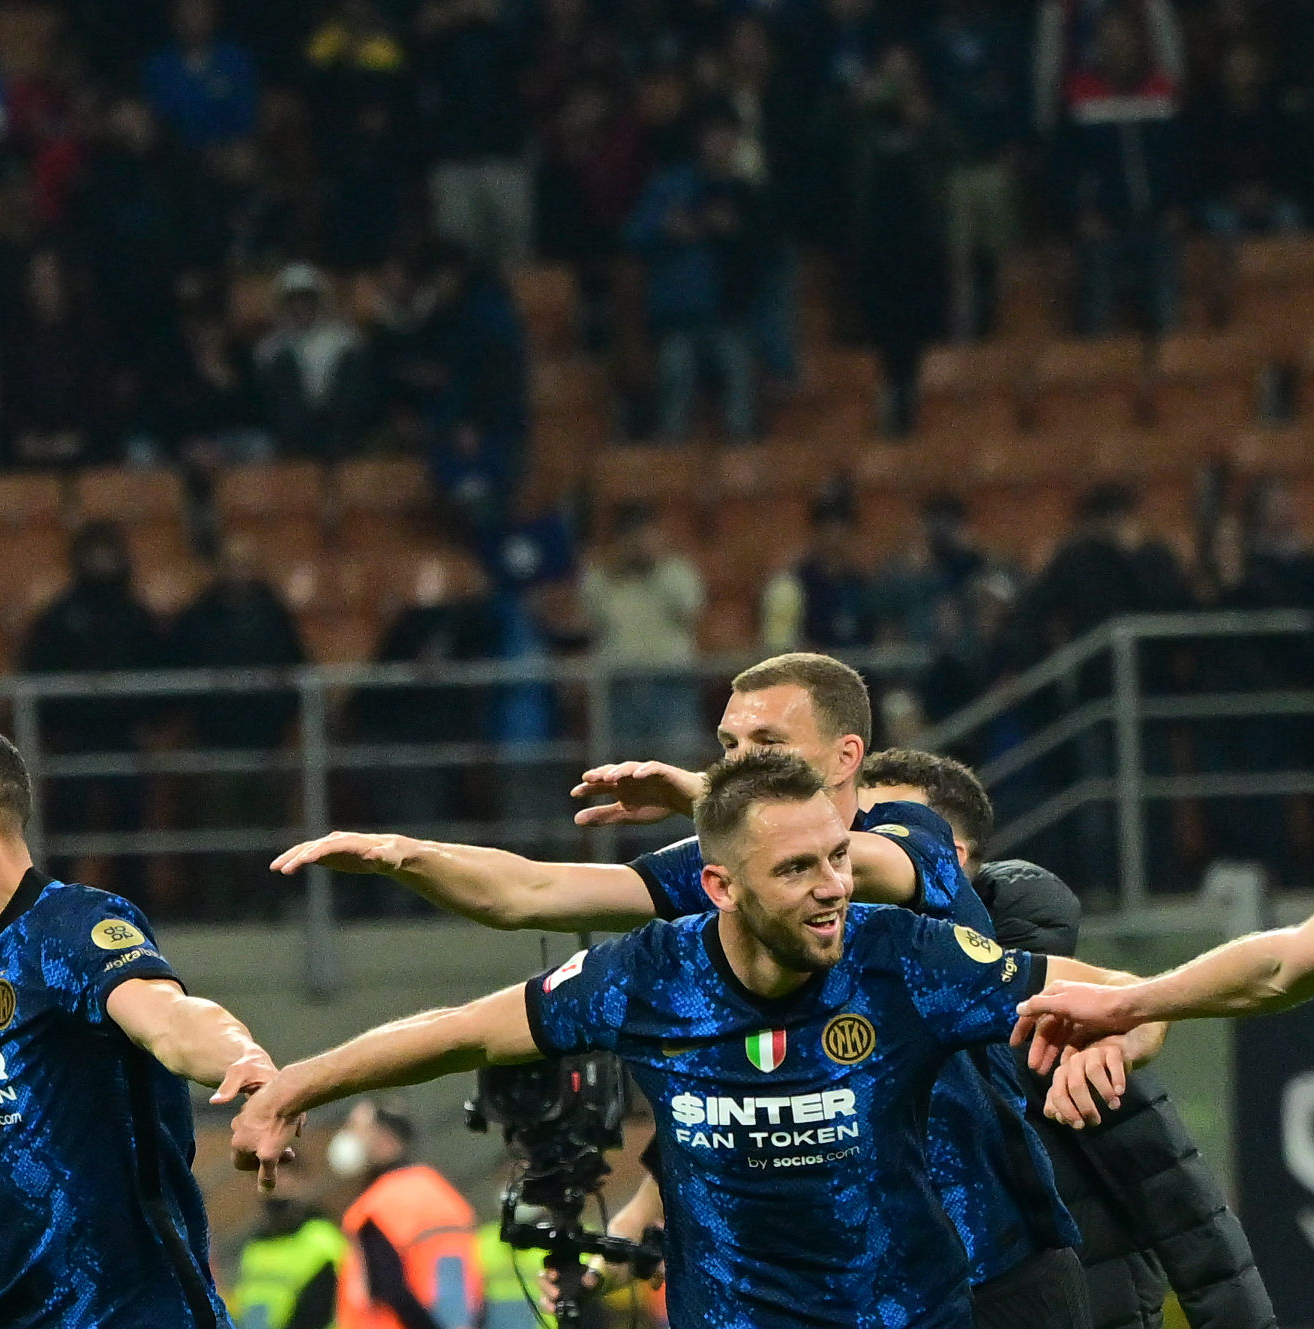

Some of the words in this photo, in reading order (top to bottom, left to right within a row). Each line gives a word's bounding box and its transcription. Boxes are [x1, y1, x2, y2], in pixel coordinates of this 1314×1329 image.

[675, 1128, 735, 1149] FAN
[748, 1120, 860, 1149] TOKEN
[747, 1156, 768, 1170] by
